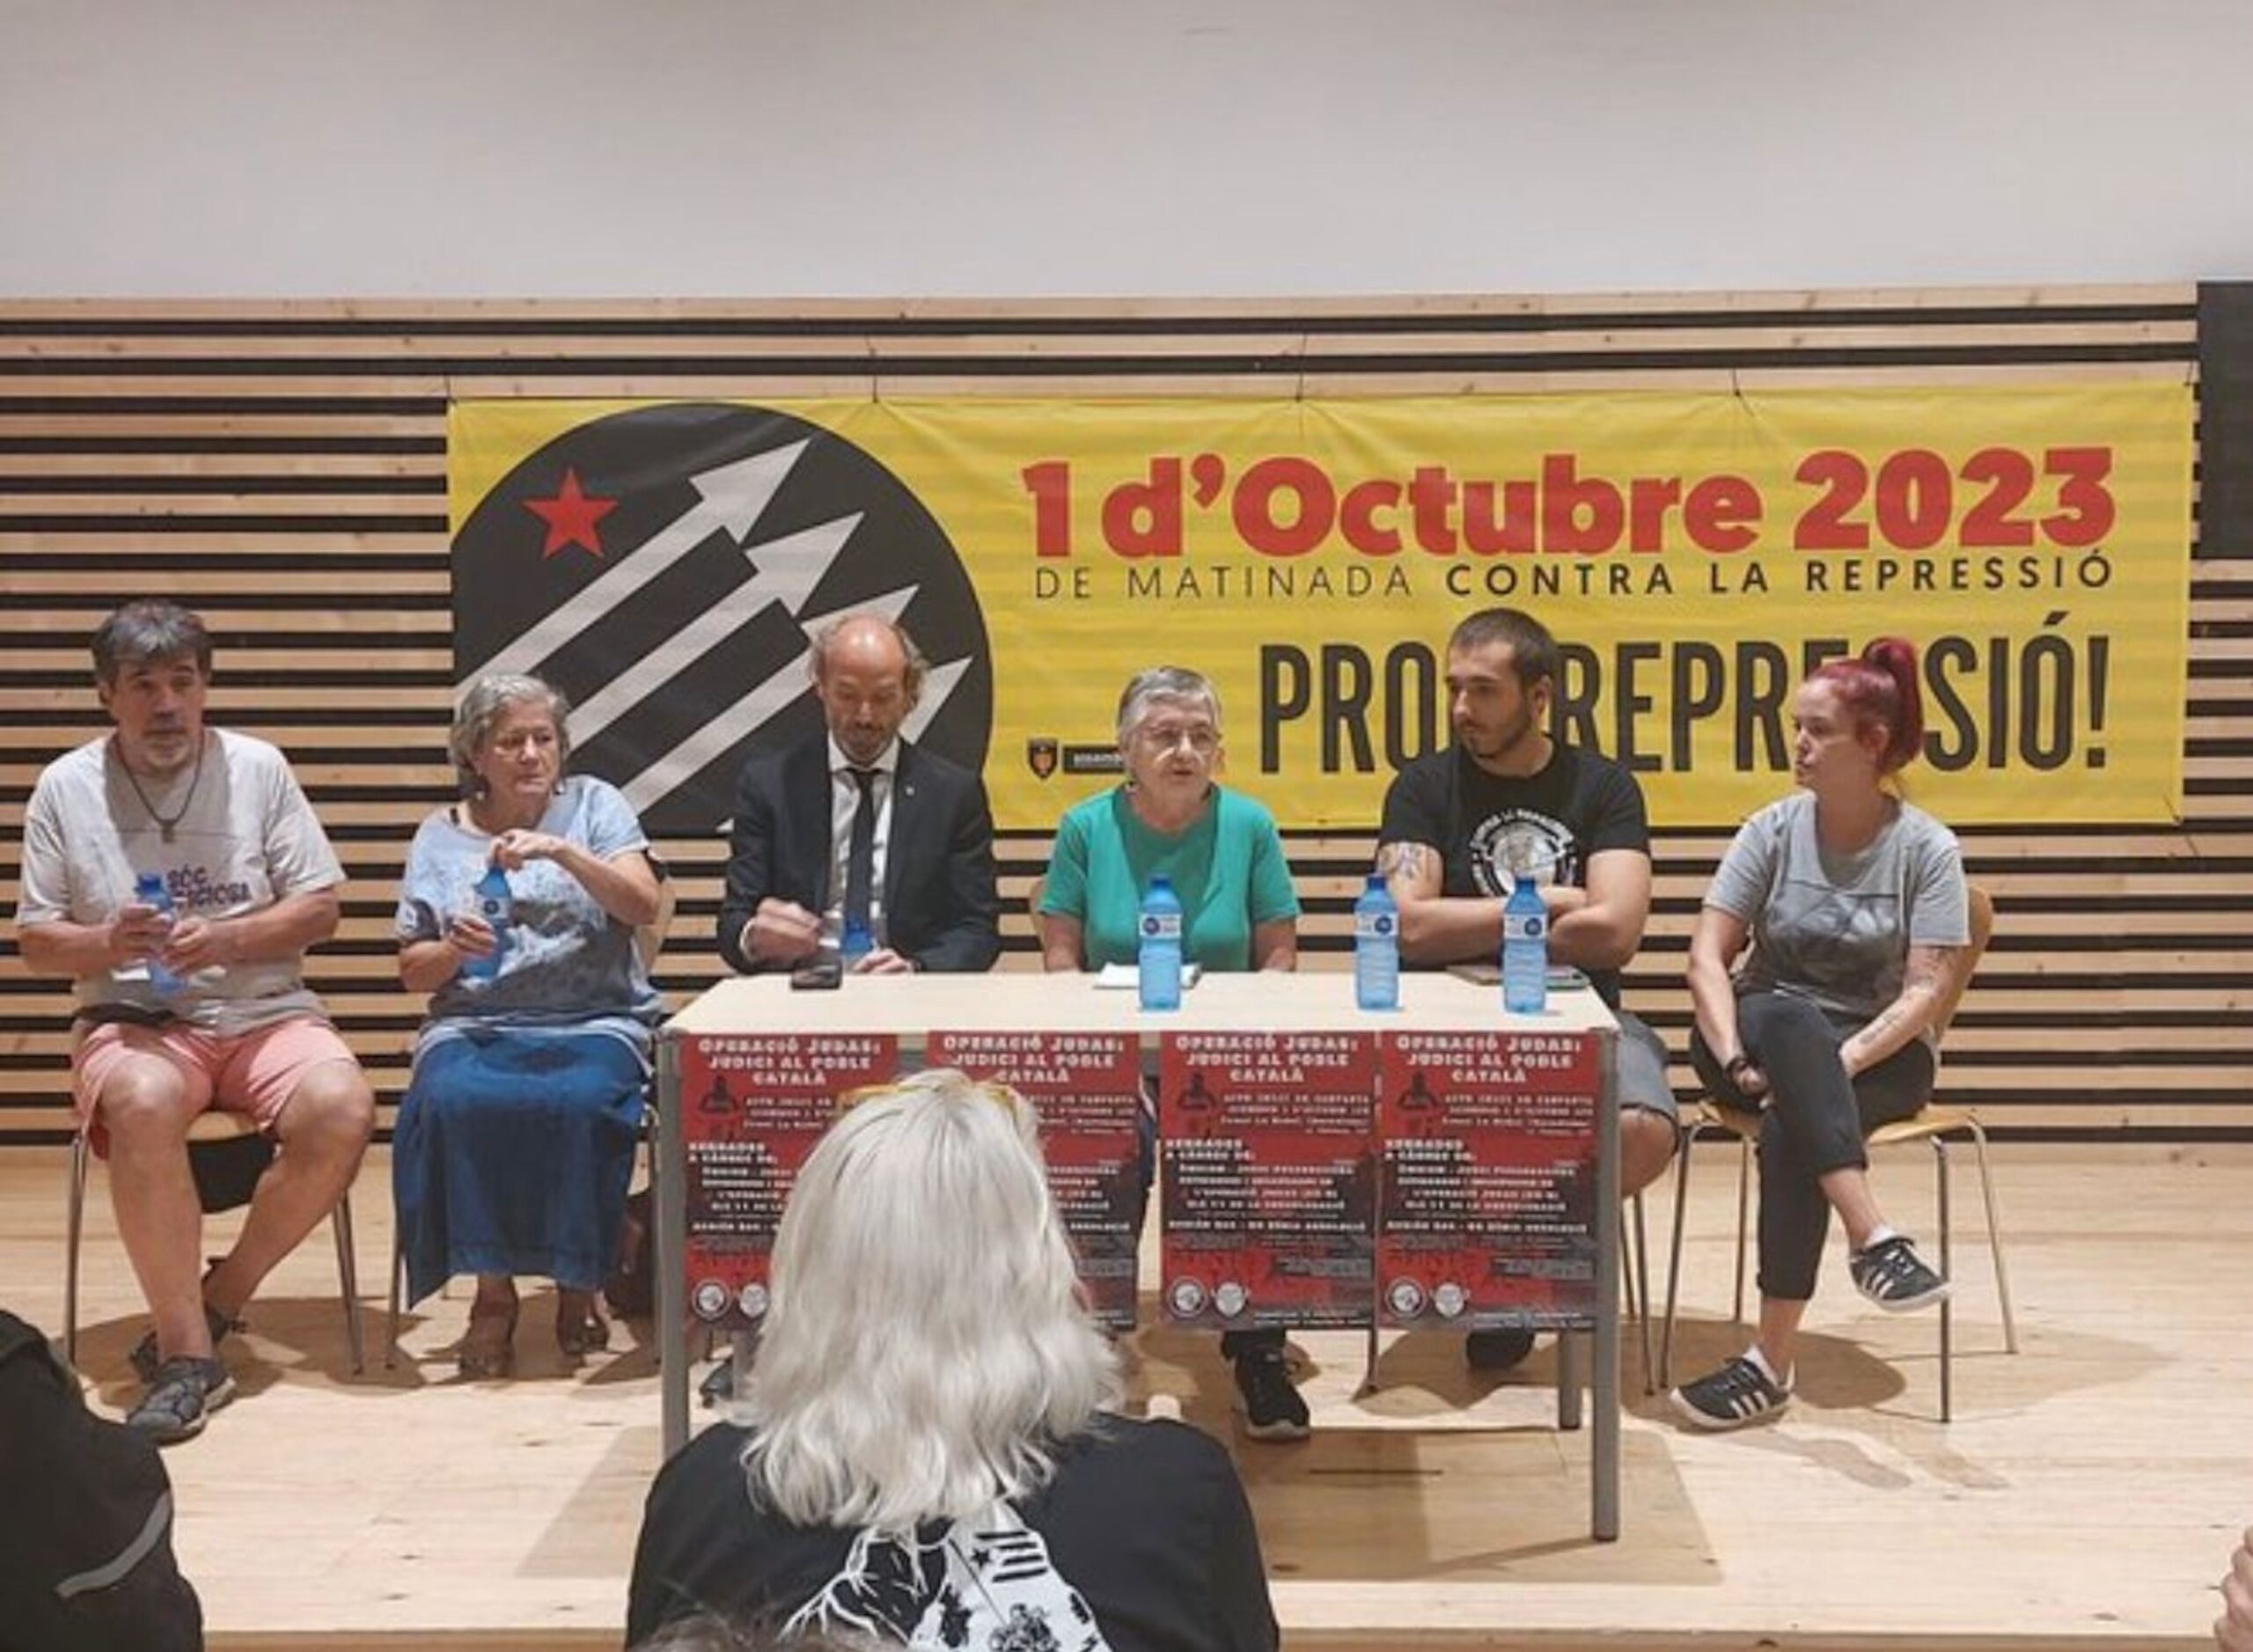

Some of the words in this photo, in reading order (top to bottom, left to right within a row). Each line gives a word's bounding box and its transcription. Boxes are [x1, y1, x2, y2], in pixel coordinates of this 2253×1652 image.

[1022, 461, 1070, 557] 1
[1794, 447, 2116, 551] 2023
[1035, 568, 1091, 598] DE
[1127, 564, 1412, 598] MATINADA
[1446, 562, 1673, 596] CONTRA
[1711, 561, 1769, 594] LA
[1806, 549, 2112, 591] REPRESSIÓ
[1261, 642, 1457, 773] PRO
[1552, 611, 2110, 772] REPRSIÓ!
